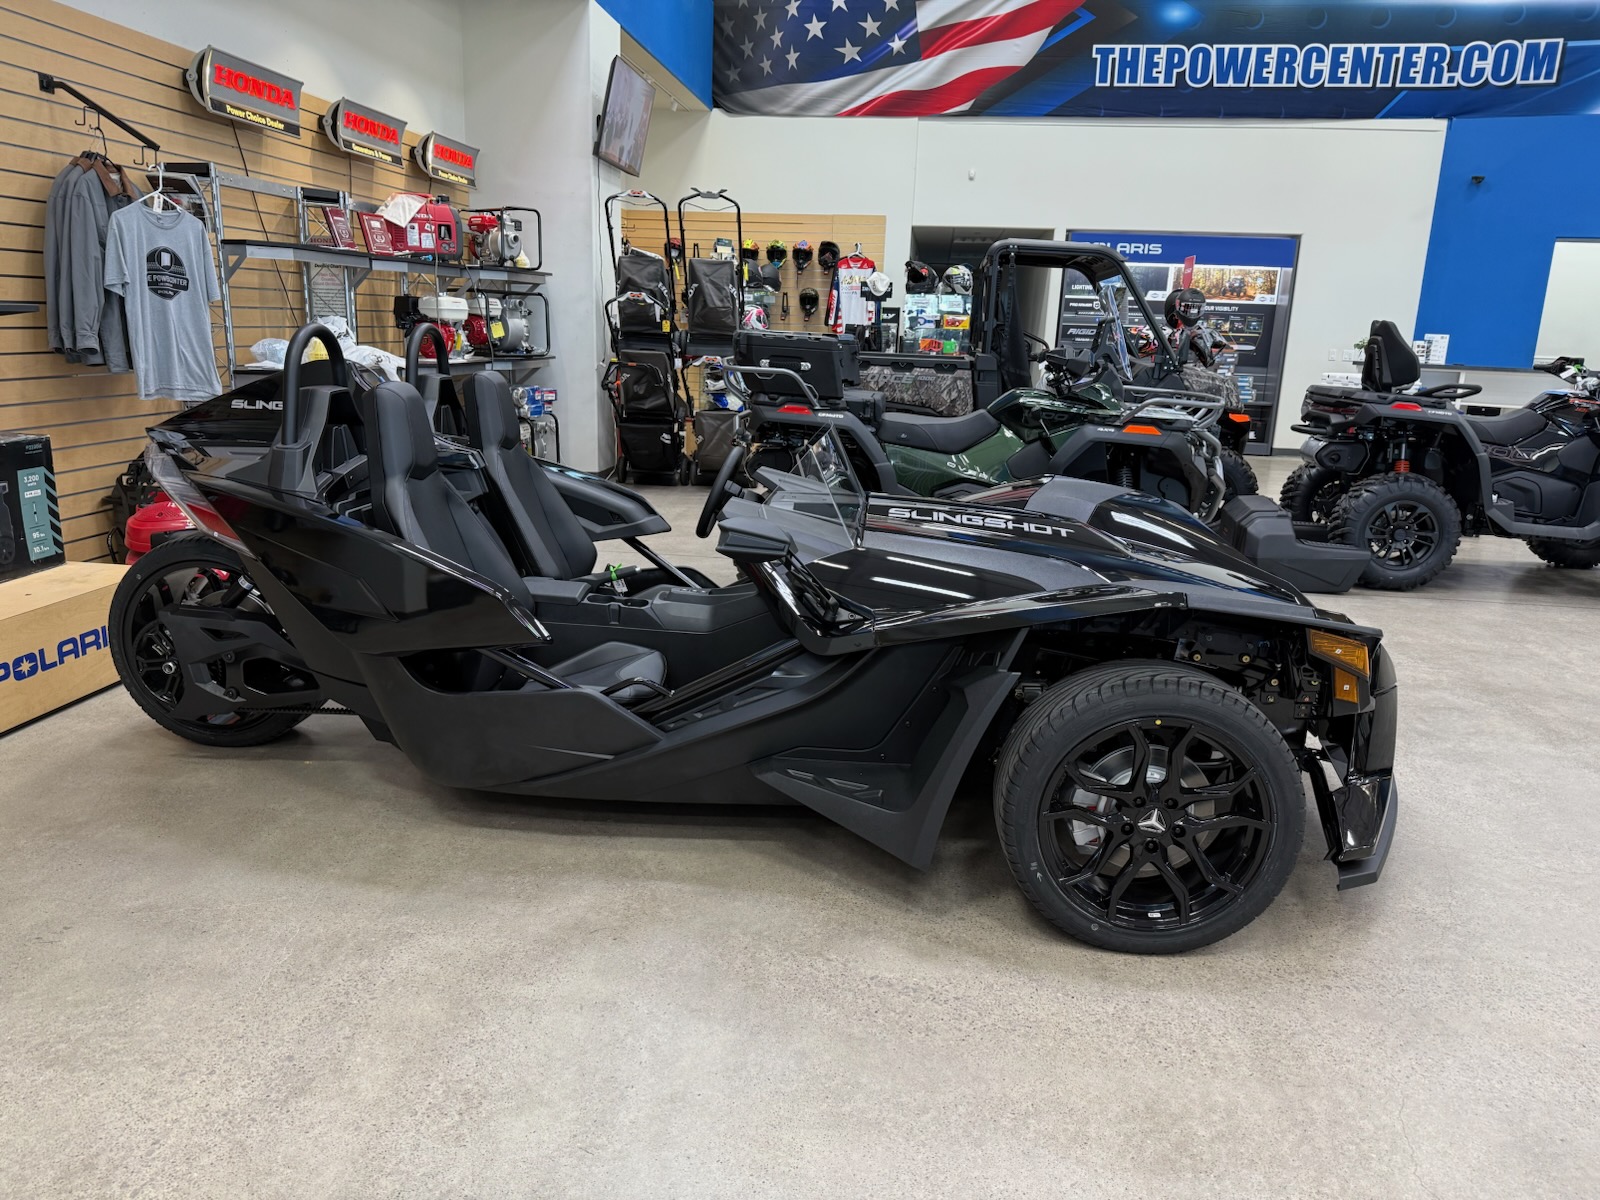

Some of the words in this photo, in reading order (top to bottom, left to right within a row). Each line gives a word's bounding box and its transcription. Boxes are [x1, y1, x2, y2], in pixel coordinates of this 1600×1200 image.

[1093, 38, 1564, 88] THEPOWERCENTER.COM
[213, 63, 297, 111] HONDA
[225, 104, 246, 119] Power
[246, 110, 266, 125] Choice
[266, 117, 285, 131] Dealer
[344, 110, 400, 145] HONDA
[434, 143, 473, 170] HONDA
[310, 236, 338, 244] HOND
[1066, 328, 1097, 336] RIGID
[23, 474, 40, 484] 3,200
[888, 507, 1075, 538] SLINGSHOT
[0, 624, 109, 683] POLARI
